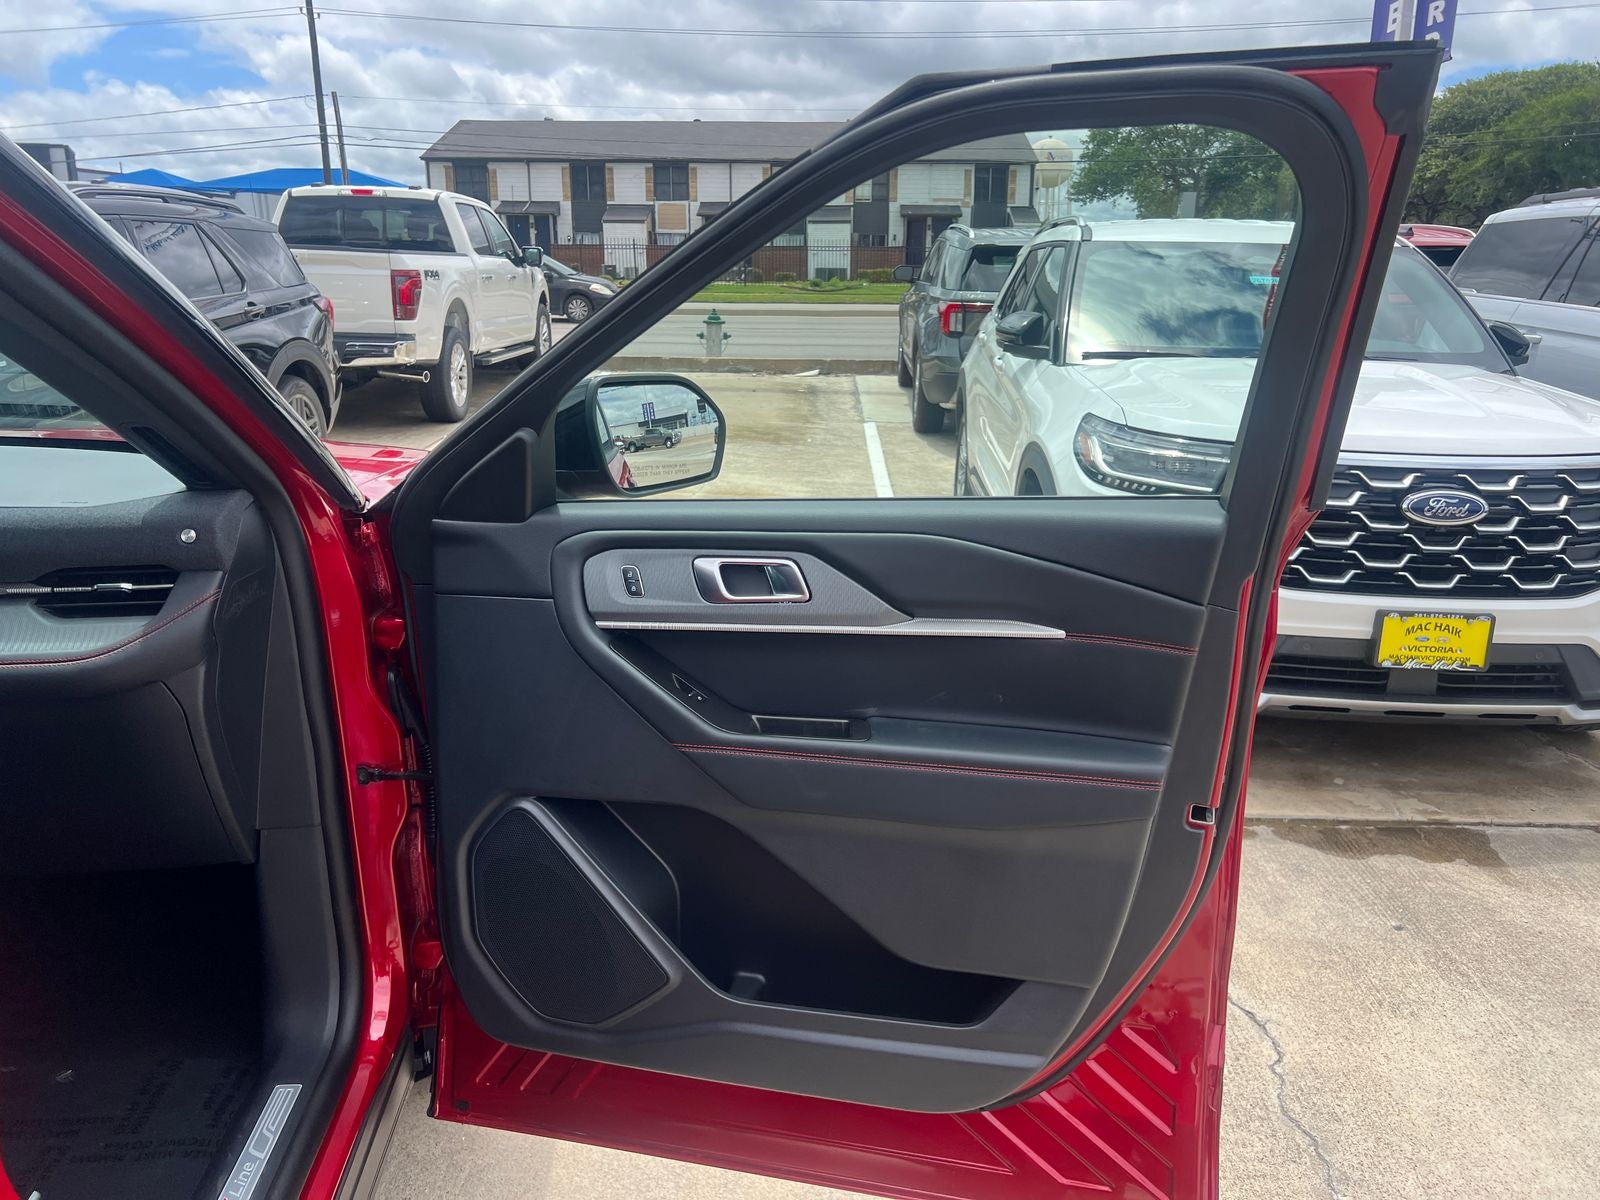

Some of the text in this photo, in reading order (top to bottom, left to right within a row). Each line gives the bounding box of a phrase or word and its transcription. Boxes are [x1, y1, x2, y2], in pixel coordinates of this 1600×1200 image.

[1423, 496, 1470, 517] Ford
[1404, 622, 1462, 639] MAC HAIK
[1407, 645, 1455, 653] VICTORIA
[228, 1161, 255, 1198] Line
